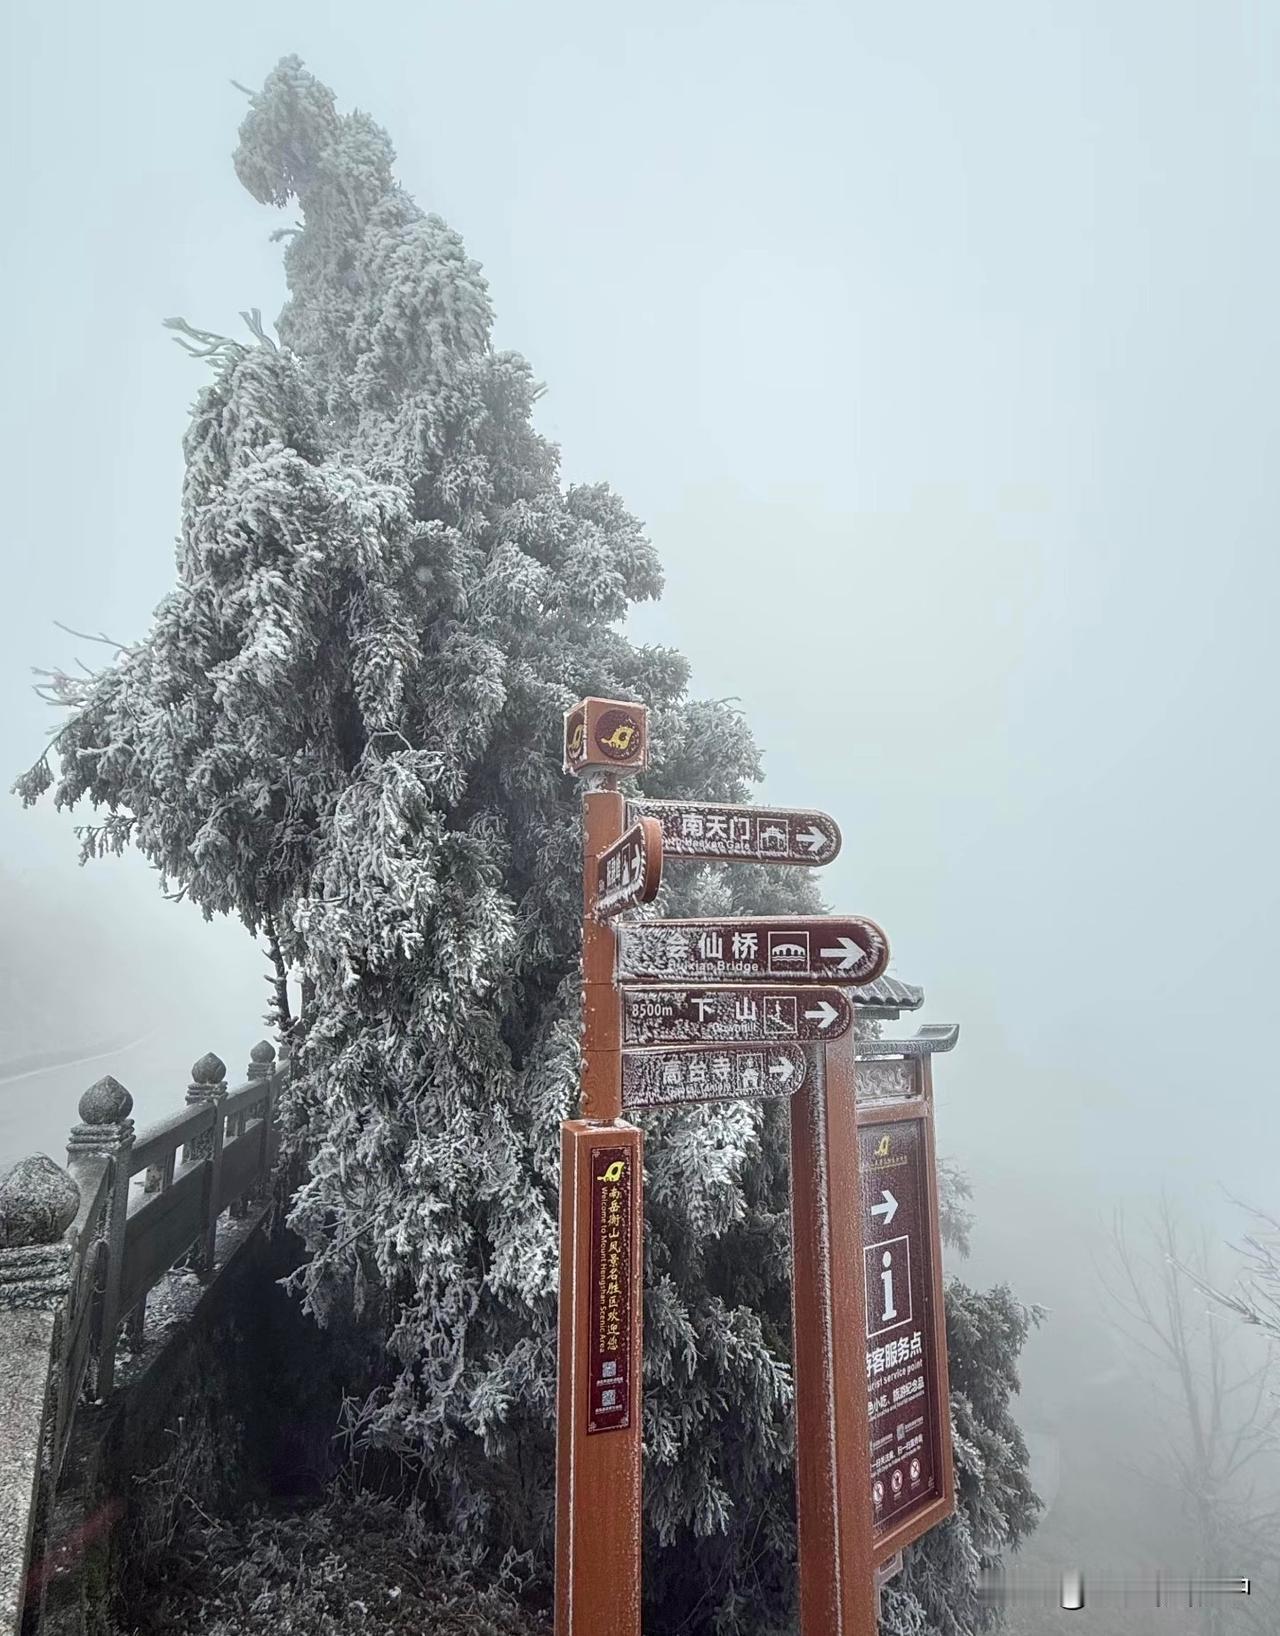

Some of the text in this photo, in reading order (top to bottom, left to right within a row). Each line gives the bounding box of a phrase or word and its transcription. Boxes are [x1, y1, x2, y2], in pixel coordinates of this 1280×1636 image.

[681, 814, 750, 840] 南天门
[666, 932, 759, 960] 会仙桥
[717, 960, 759, 974] Bridge
[631, 1003, 673, 1017] 8500m
[691, 996, 757, 1022] 下山
[662, 1055, 731, 1084] 高台寺
[606, 1186, 621, 1351] 南岳衡山风景名胜区欢迎您
[599, 1263, 607, 1305] Hengshan
[599, 1306, 607, 1333] Scenic
[868, 1358, 923, 1393] urist service point
